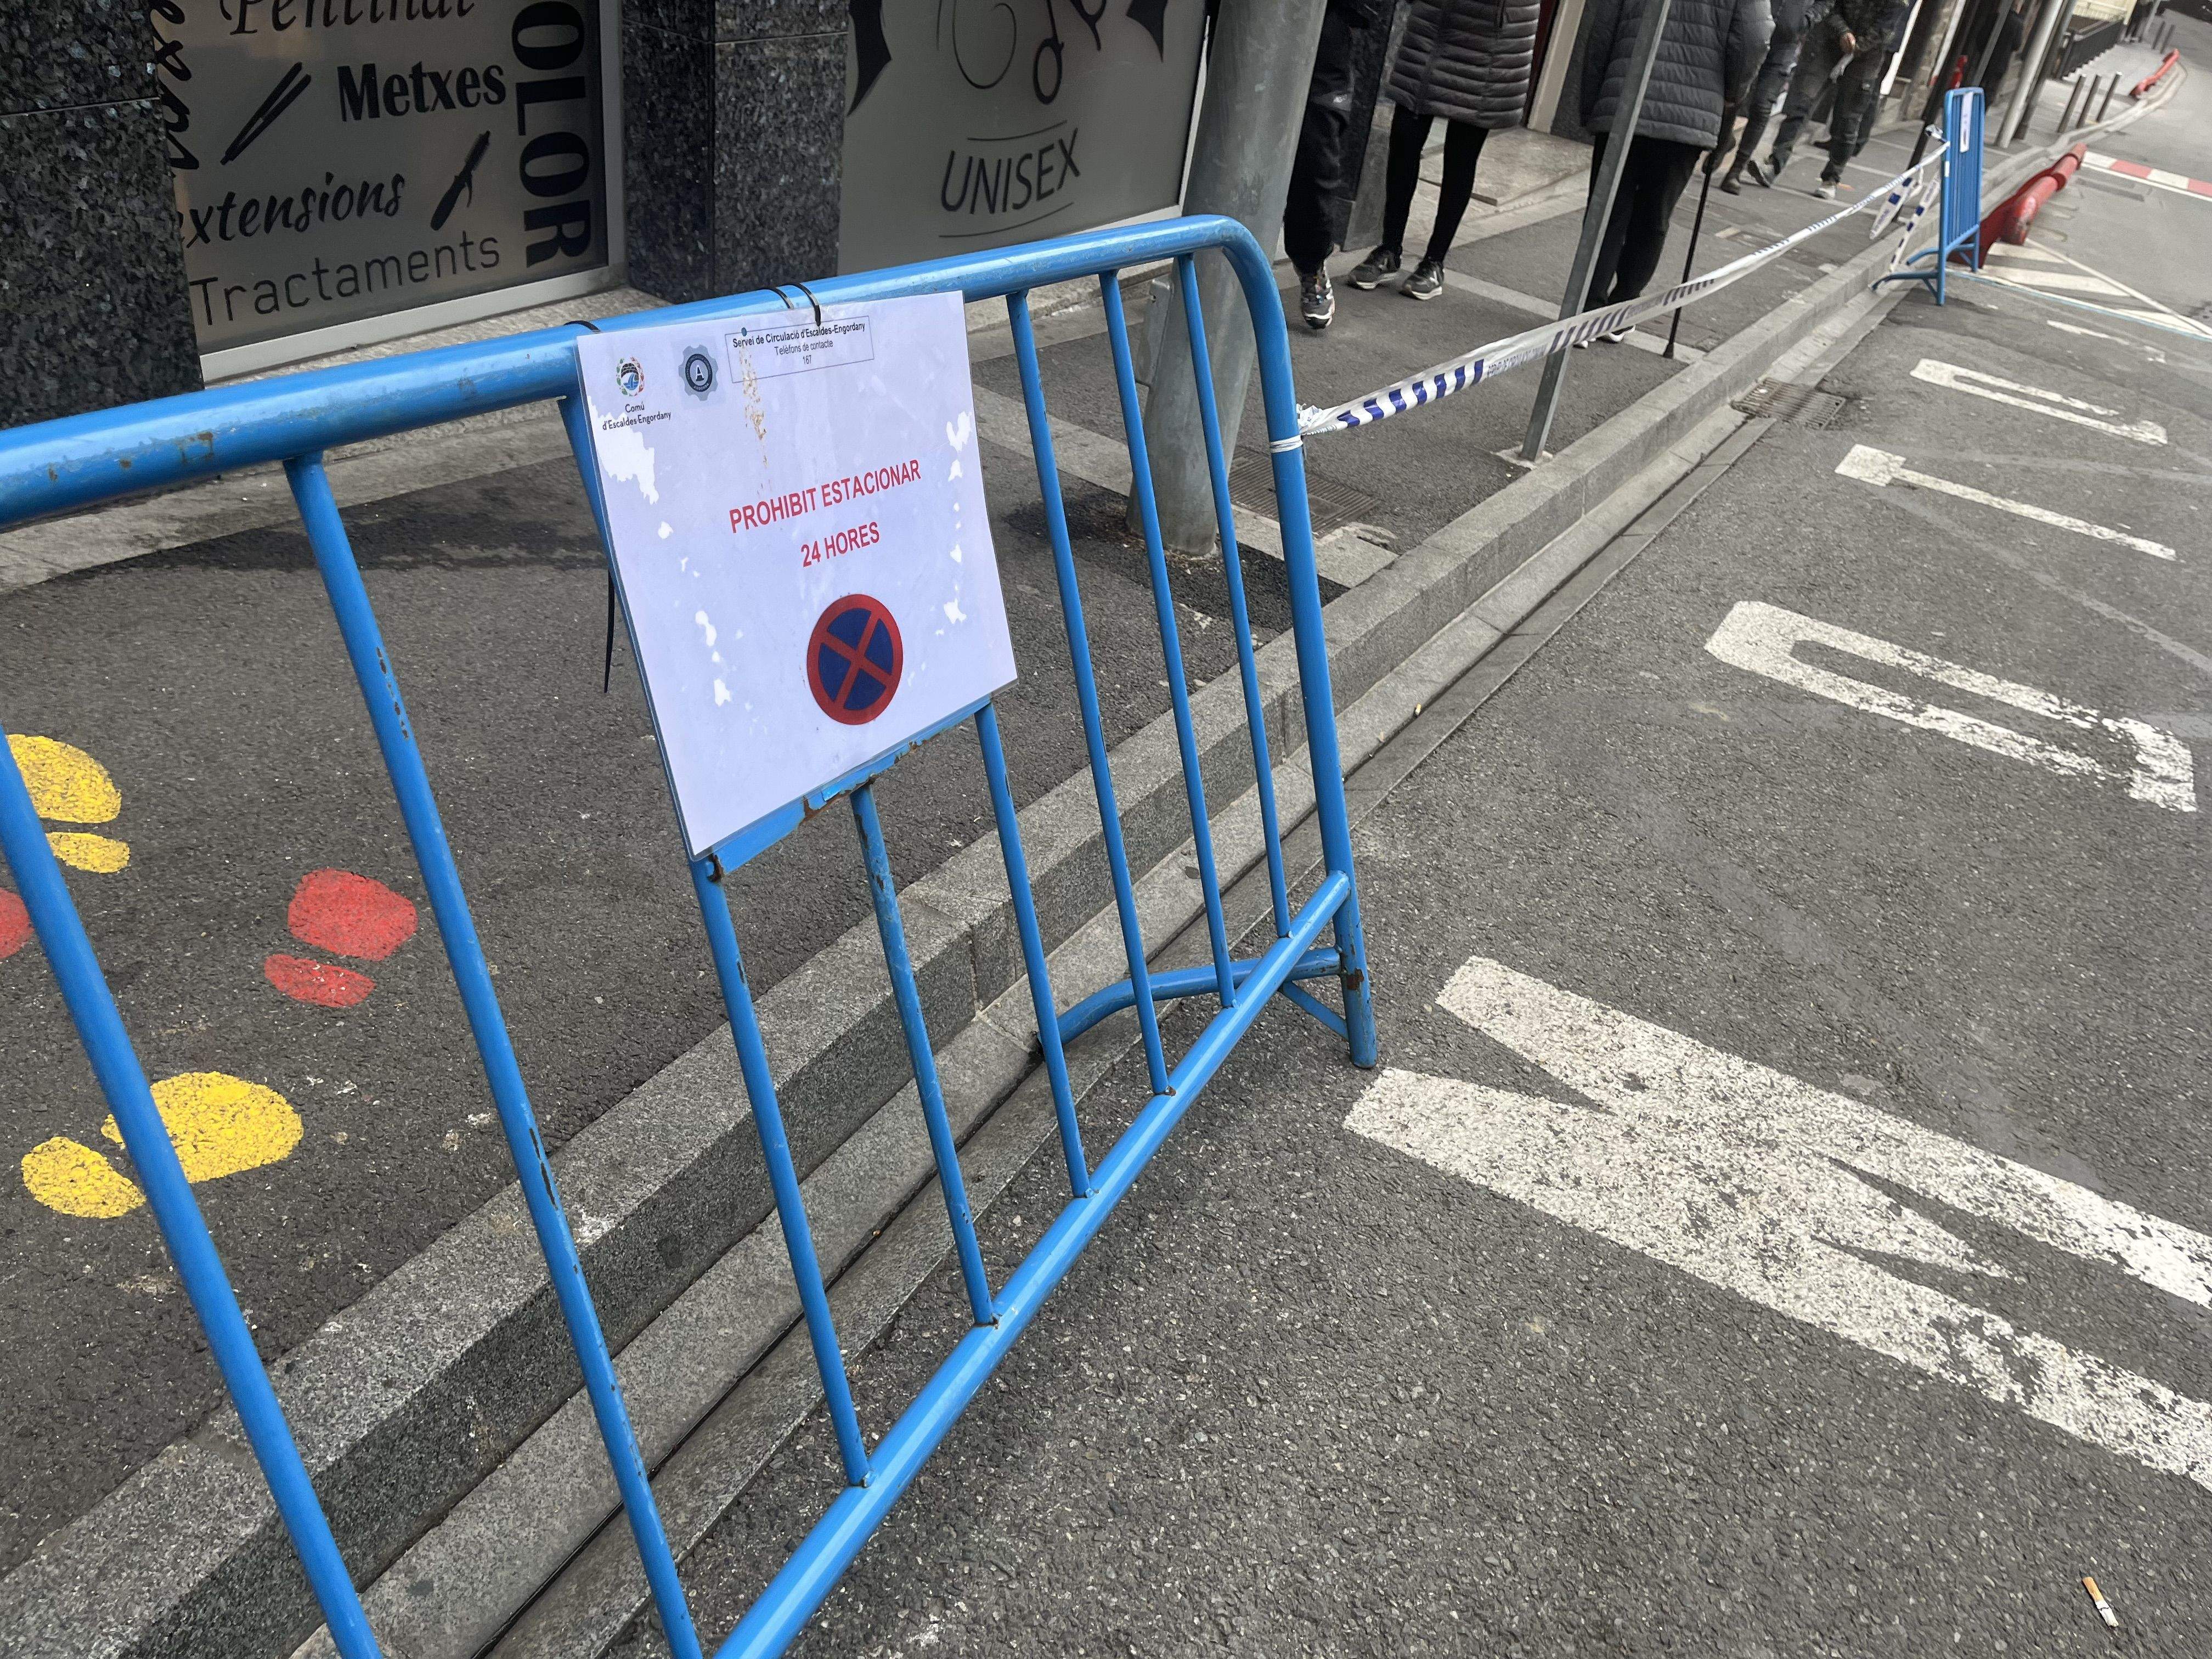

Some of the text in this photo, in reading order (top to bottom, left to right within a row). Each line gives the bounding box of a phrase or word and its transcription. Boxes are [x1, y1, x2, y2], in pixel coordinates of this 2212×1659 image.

[337, 61, 507, 122] Metxes
[940, 127, 1081, 214] UNISEX
[189, 230, 501, 326] Tractaments
[733, 321, 866, 348] Servei de Circulació d'Escaldes-Engordany
[774, 338, 833, 356] Telèfons de contacte
[803, 354, 812, 365] 167
[625, 401, 645, 413] Comú
[729, 459, 921, 533] PROHIBIT ESTACIONAR
[800, 522, 880, 567] 24 HORES
